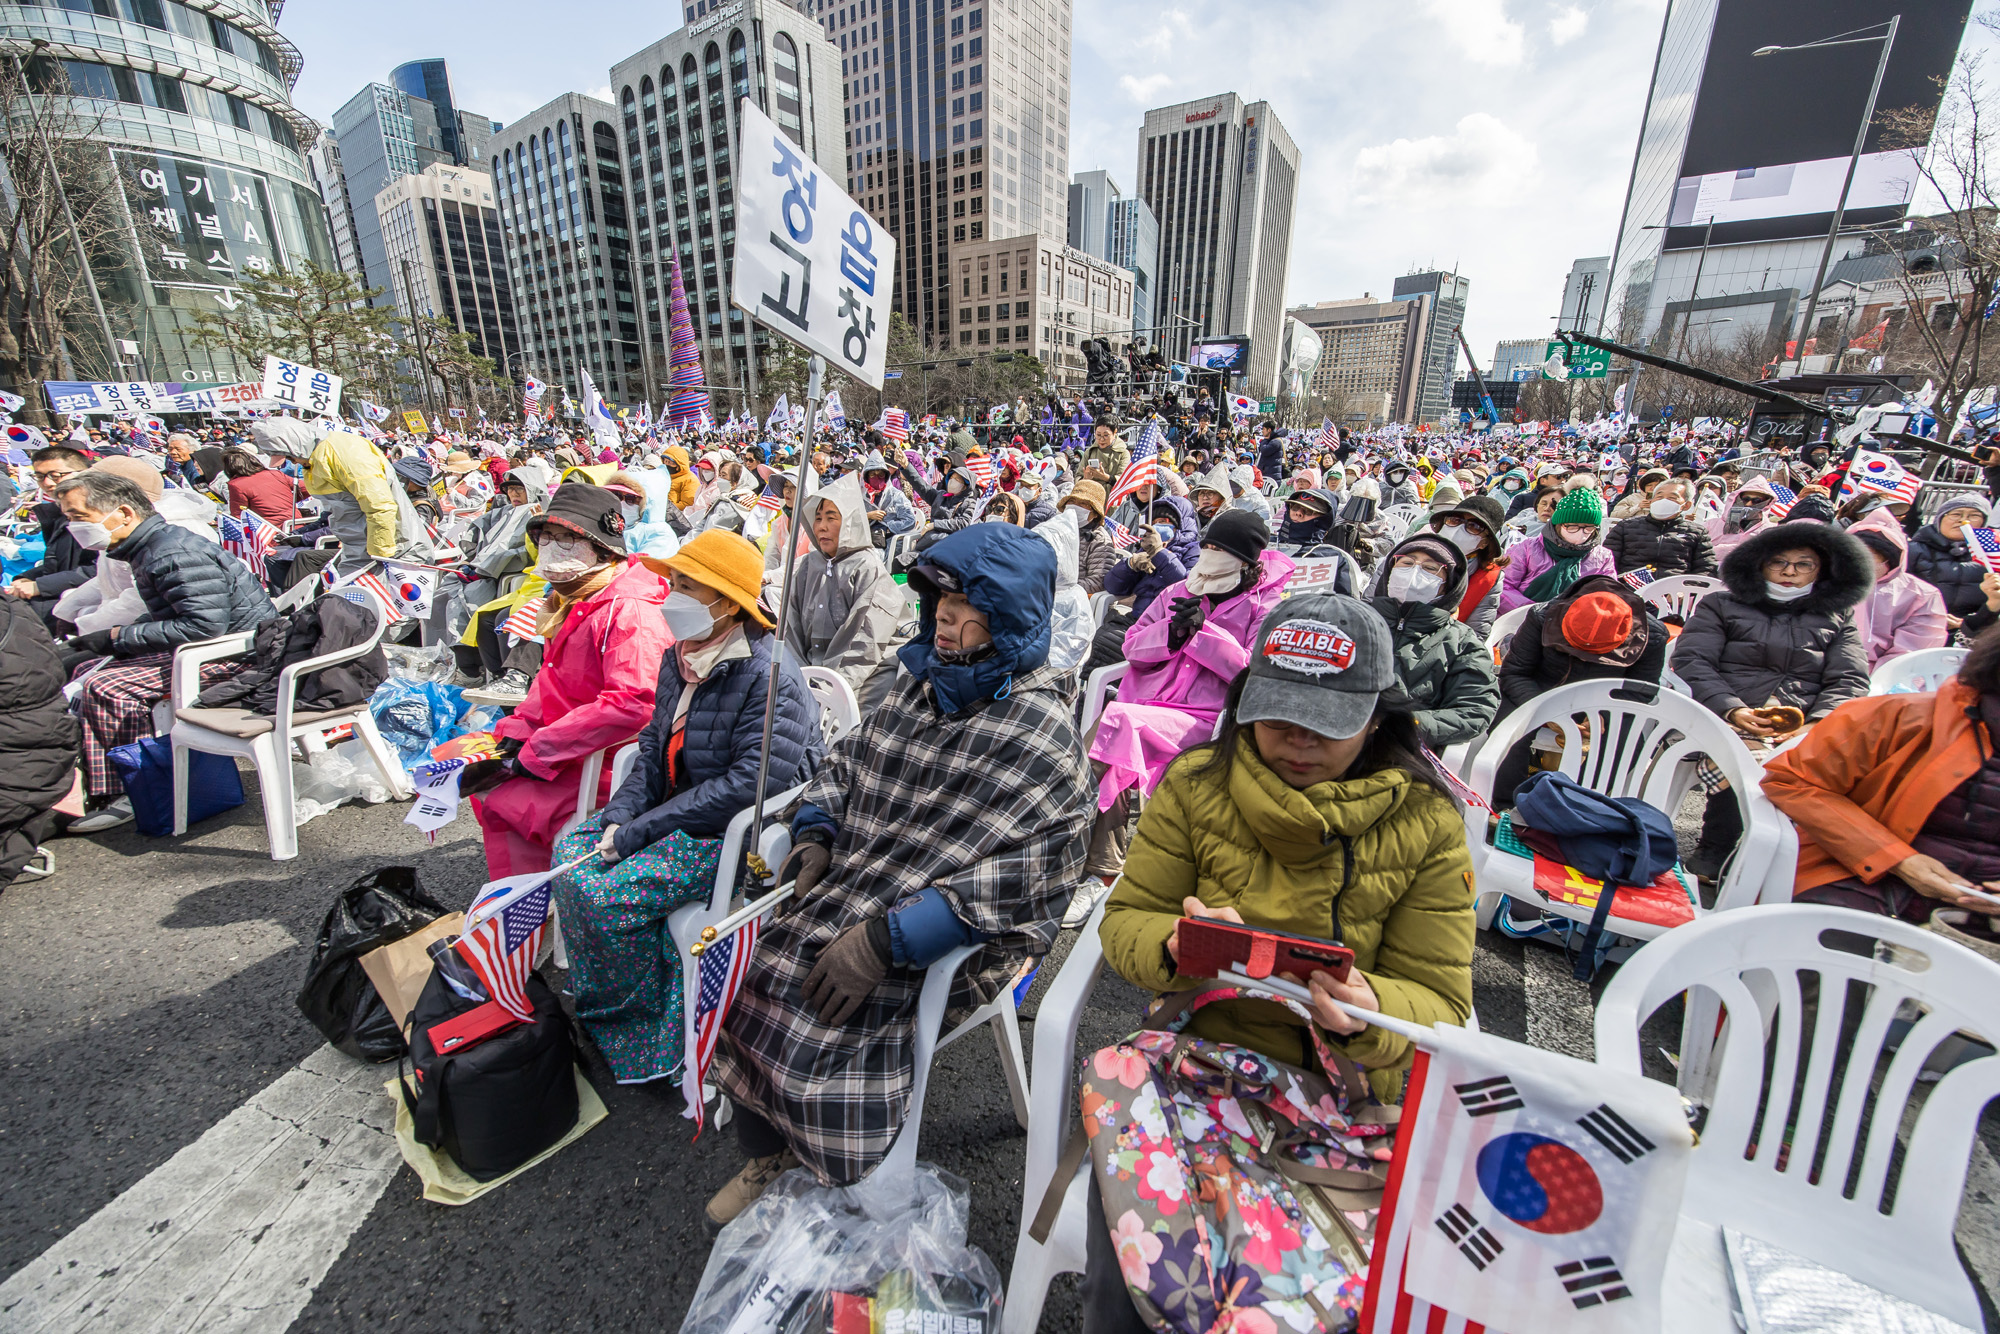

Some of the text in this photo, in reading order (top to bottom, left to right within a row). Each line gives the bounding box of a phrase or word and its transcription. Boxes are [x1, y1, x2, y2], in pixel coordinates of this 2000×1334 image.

[688, 1, 743, 38] Premier Place
[1185, 109, 1217, 124] kobaco
[140, 168, 255, 211] 여기서
[149, 206, 224, 239] 채널
[772, 136, 878, 297] 정읍
[161, 244, 234, 273] 뉴스
[761, 230, 876, 368] 고창
[277, 361, 332, 394] 정읍
[1576, 366, 1582, 374] 6
[101, 383, 146, 399] 정읍
[108, 397, 152, 412] 고창
[173, 391, 216, 412] 즉시
[273, 381, 332, 411] 고창
[1289, 563, 1332, 586] 무효
[1269, 629, 1353, 657] RELIABLE
